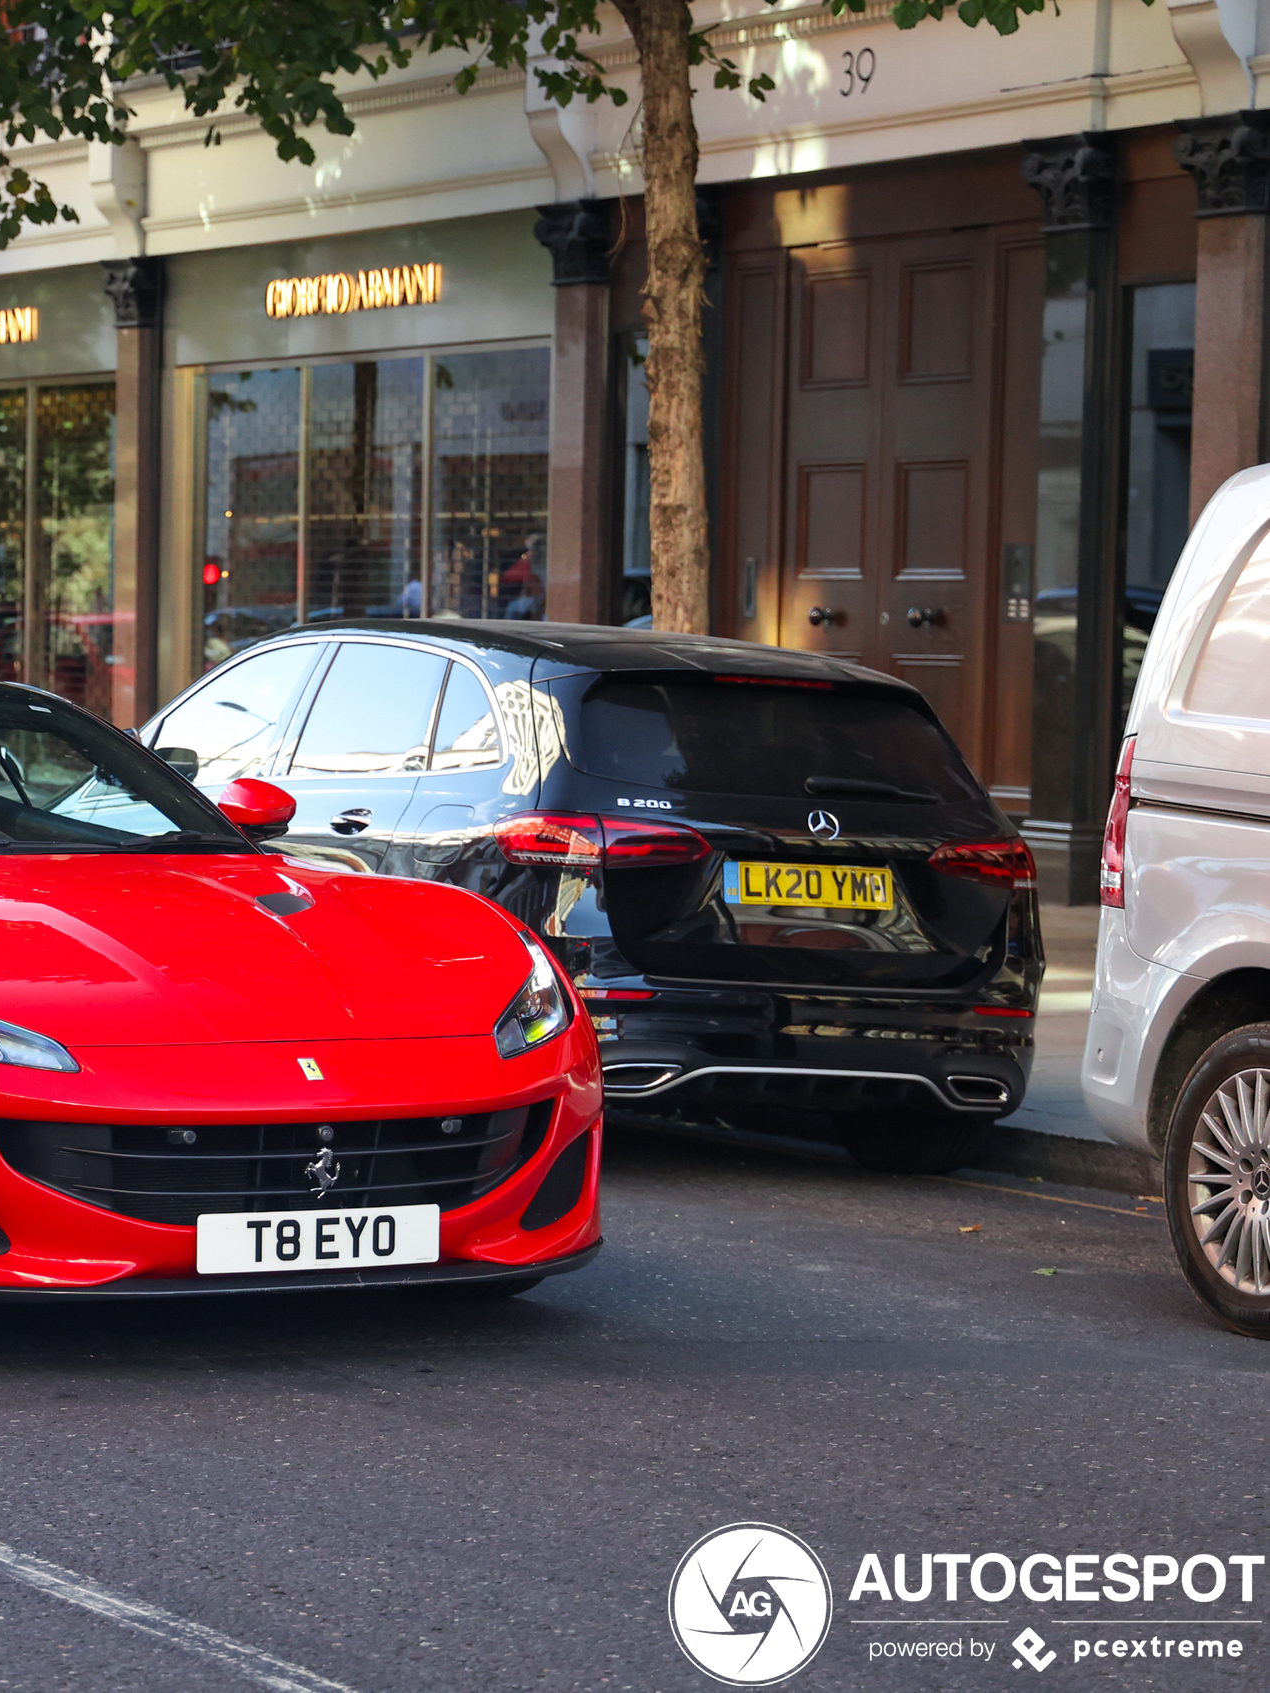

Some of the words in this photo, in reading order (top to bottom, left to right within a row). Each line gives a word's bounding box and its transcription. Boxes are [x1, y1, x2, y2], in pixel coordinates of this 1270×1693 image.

[840, 47, 876, 97] 39
[266, 272, 354, 319] GIORGIO
[354, 263, 442, 311] ARMANI
[616, 797, 631, 807] B
[633, 798, 673, 810] 200
[744, 866, 822, 900] LK20
[247, 1219, 301, 1263] T8
[315, 1214, 396, 1260] EYO
